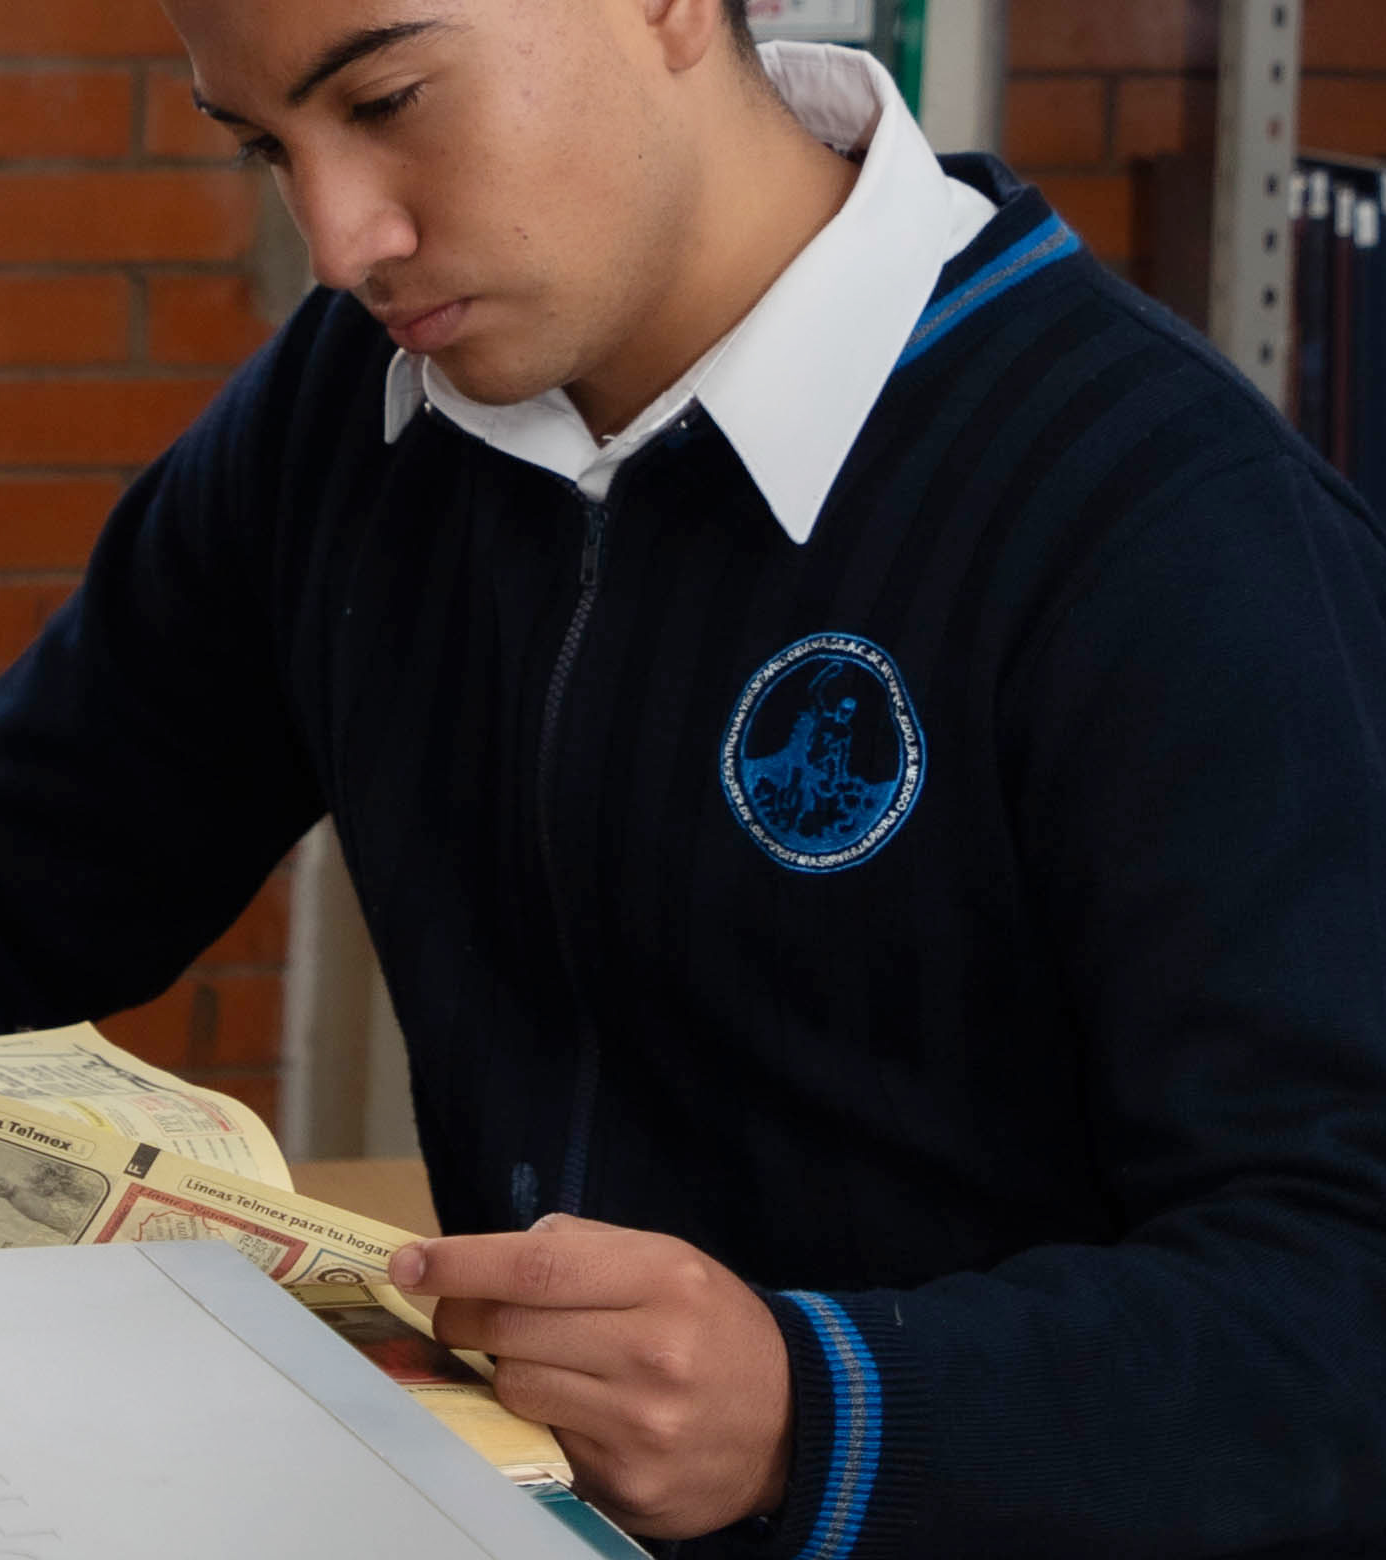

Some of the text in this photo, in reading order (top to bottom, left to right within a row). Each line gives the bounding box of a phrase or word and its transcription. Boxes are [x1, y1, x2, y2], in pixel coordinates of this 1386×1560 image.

[8, 1120, 73, 1152] Telmex
[127, 1162, 143, 1176] F
[185, 1178, 392, 1261] Líneas Telmex para tu hogar
